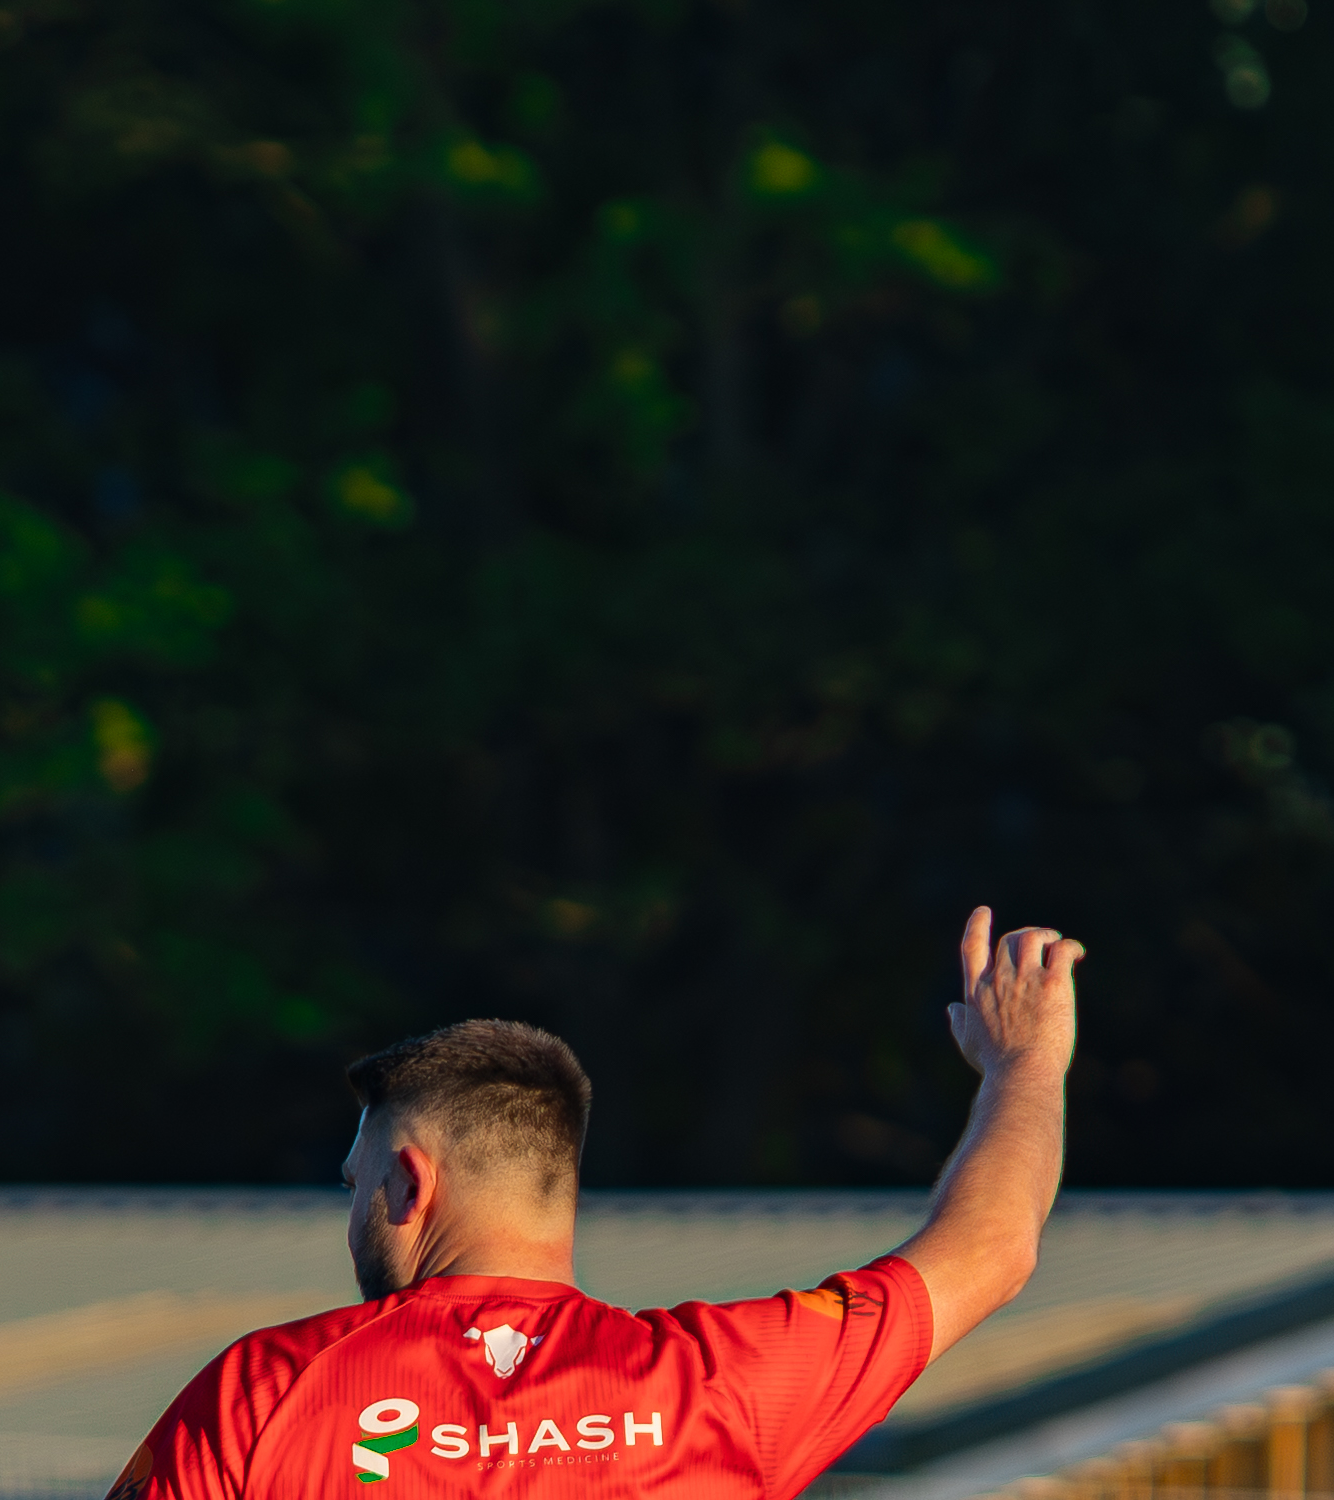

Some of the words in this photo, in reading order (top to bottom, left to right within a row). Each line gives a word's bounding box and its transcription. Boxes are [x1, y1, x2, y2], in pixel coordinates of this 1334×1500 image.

[430, 1411, 664, 1459] SHASH
[476, 1458, 536, 1471] SPORTS
[543, 1452, 620, 1466] MEDICINE
